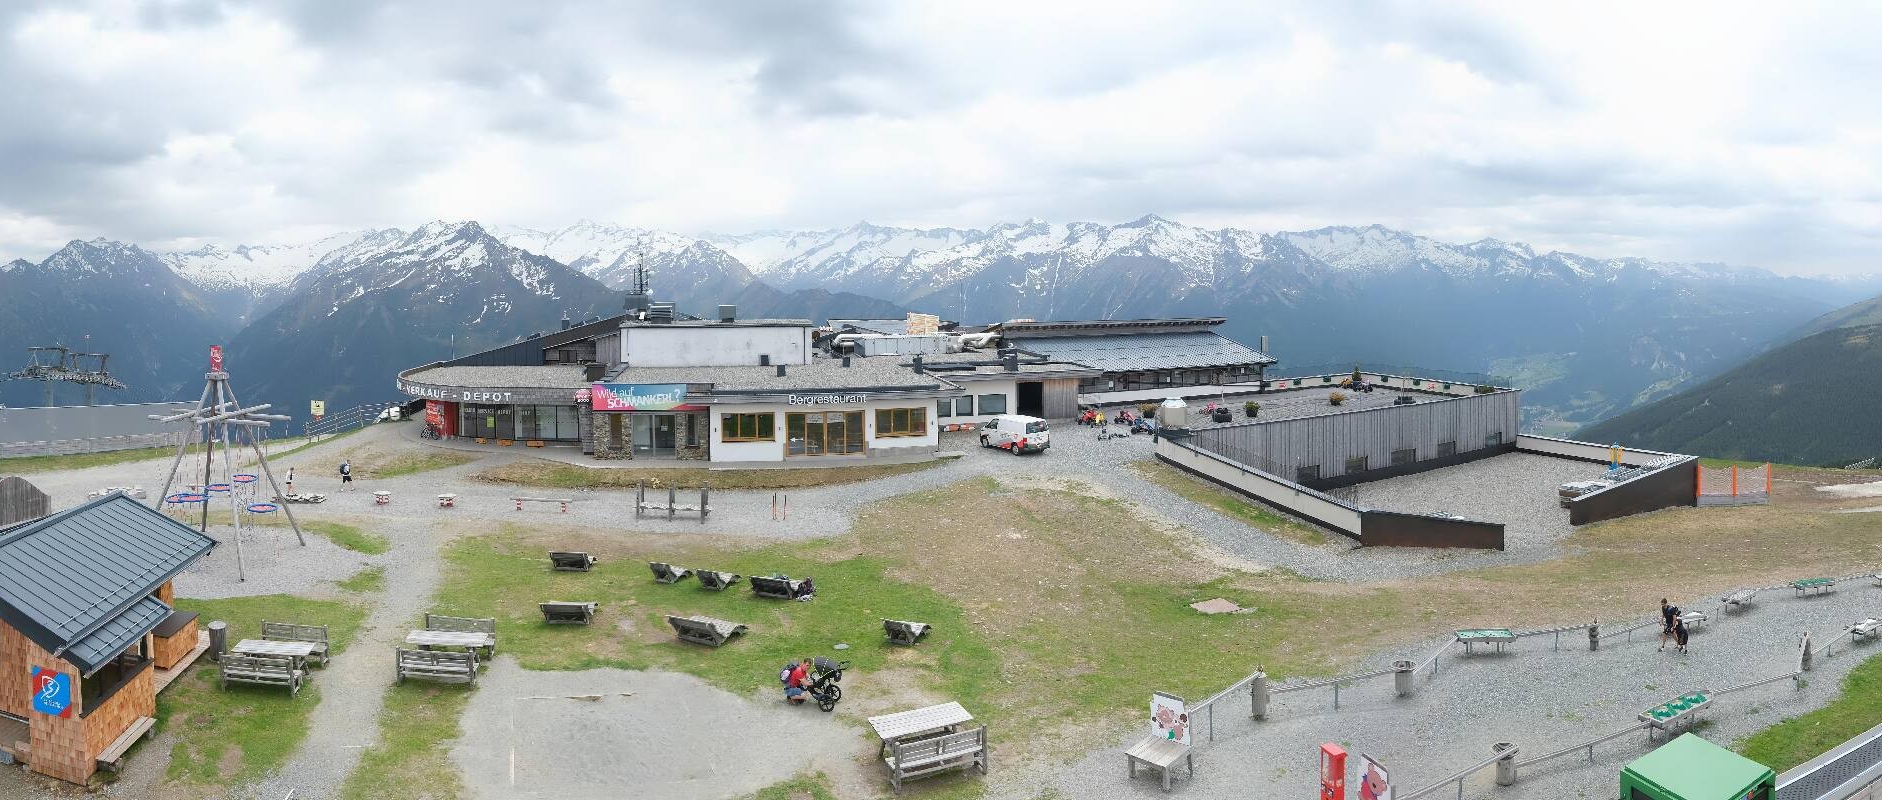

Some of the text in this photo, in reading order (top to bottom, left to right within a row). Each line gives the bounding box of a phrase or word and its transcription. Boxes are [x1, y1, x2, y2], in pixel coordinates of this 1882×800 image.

[406, 384, 448, 399] VERKAUF
[463, 391, 512, 402] DEPOT
[596, 386, 635, 399] Wild auf
[788, 393, 867, 406] Bergrestaurant
